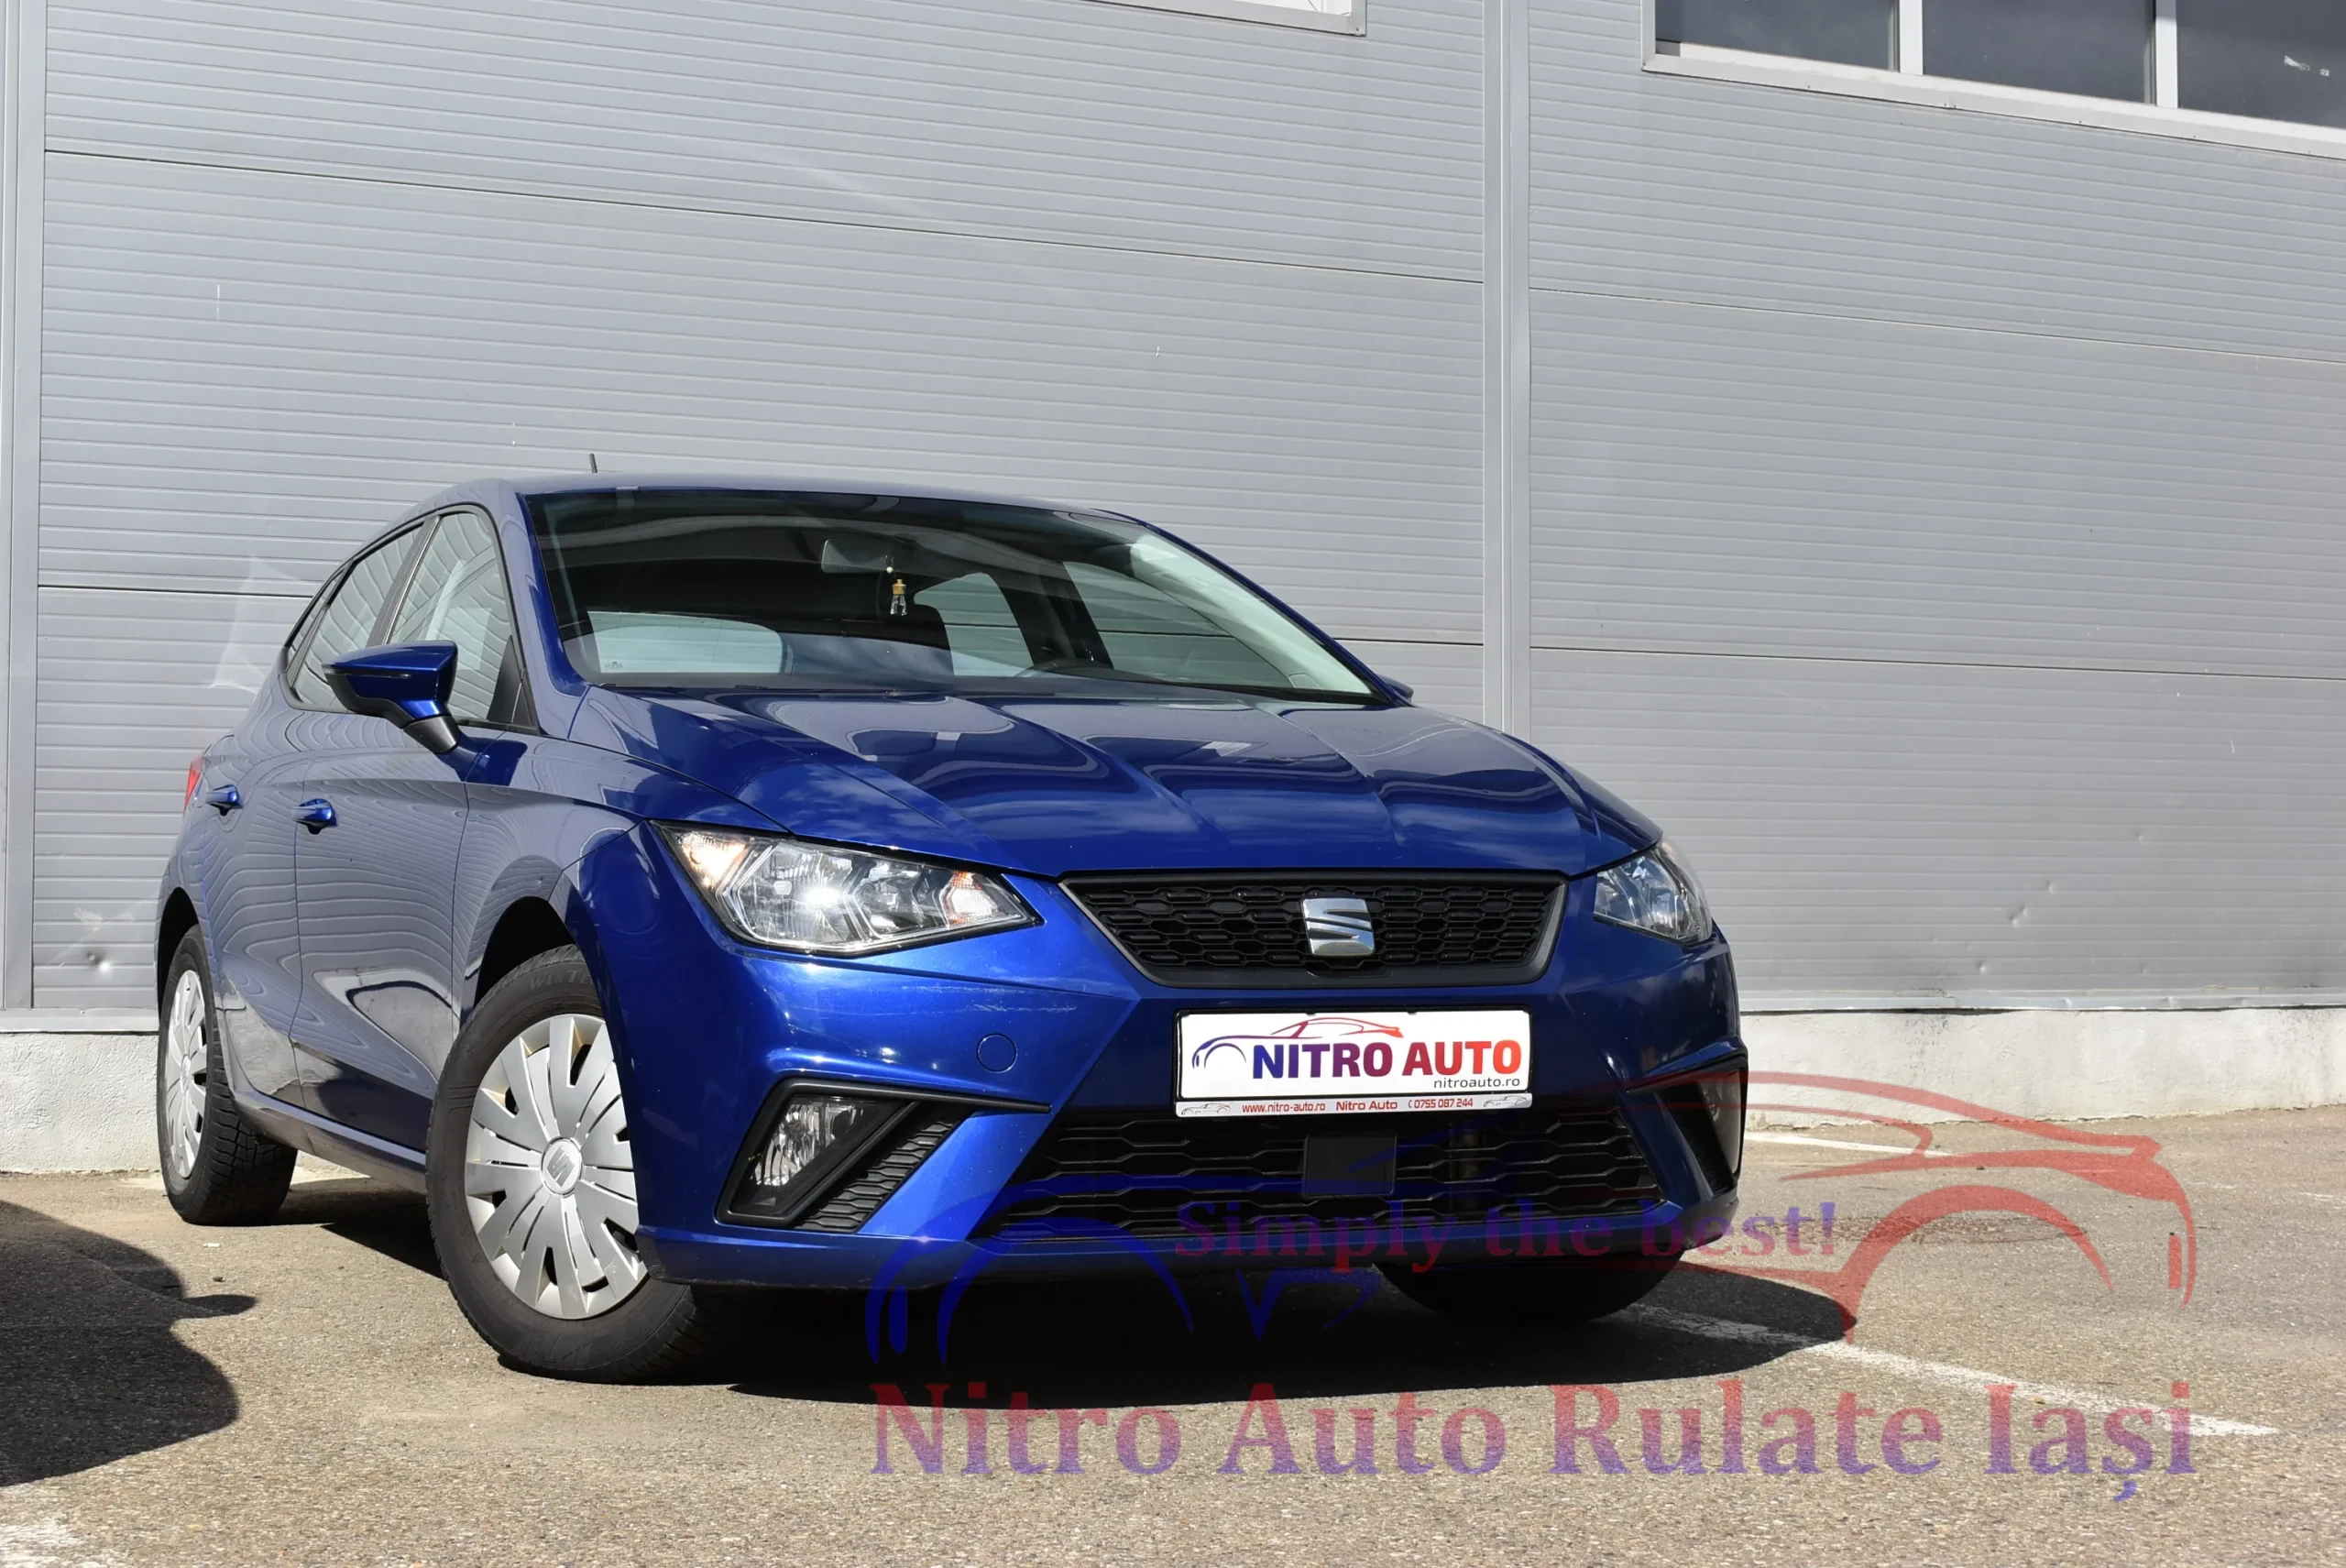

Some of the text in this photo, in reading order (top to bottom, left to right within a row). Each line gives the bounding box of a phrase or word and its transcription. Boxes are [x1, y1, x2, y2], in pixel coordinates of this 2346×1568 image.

[530, 969, 594, 991] WINTE
[1252, 1039, 1521, 1080] NITRO AUTO
[1432, 1077, 1521, 1090] nitroauto.ro
[1242, 1098, 1474, 1113] www.nitro-auto.ro Nitro Auto 0755 087 244
